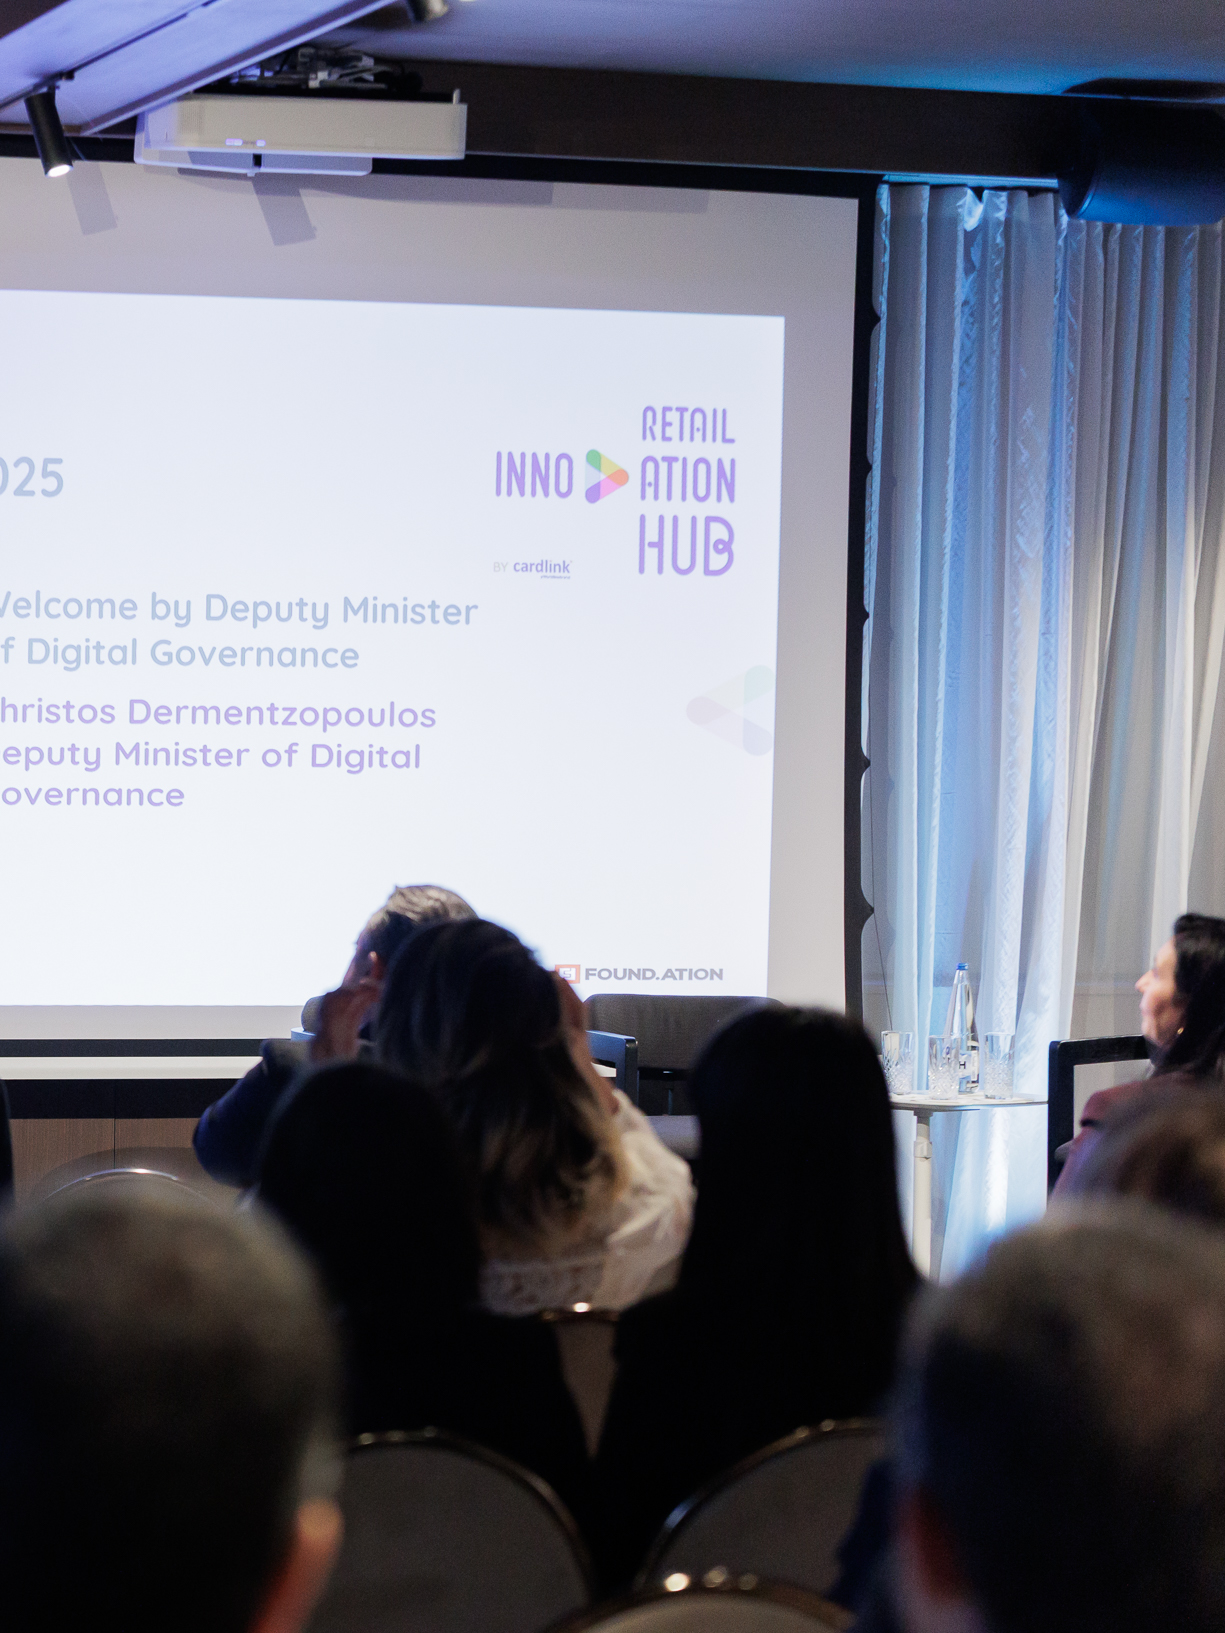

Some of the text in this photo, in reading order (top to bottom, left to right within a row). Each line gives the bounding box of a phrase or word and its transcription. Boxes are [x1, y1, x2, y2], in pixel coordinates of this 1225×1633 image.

[641, 405, 736, 444] RETAIL
[495, 450, 736, 504] INNO ATION
[638, 513, 735, 577] HUB
[493, 559, 570, 574] BY cardlink
[150, 591, 192, 629] by
[205, 593, 330, 631] Deputy
[342, 595, 479, 626] Minister
[27, 637, 138, 673] Digital
[150, 639, 360, 669] Governance
[128, 698, 437, 734] Dermentzopoulos
[114, 741, 251, 768] Minister
[261, 741, 300, 768] of
[310, 743, 421, 775] Digital
